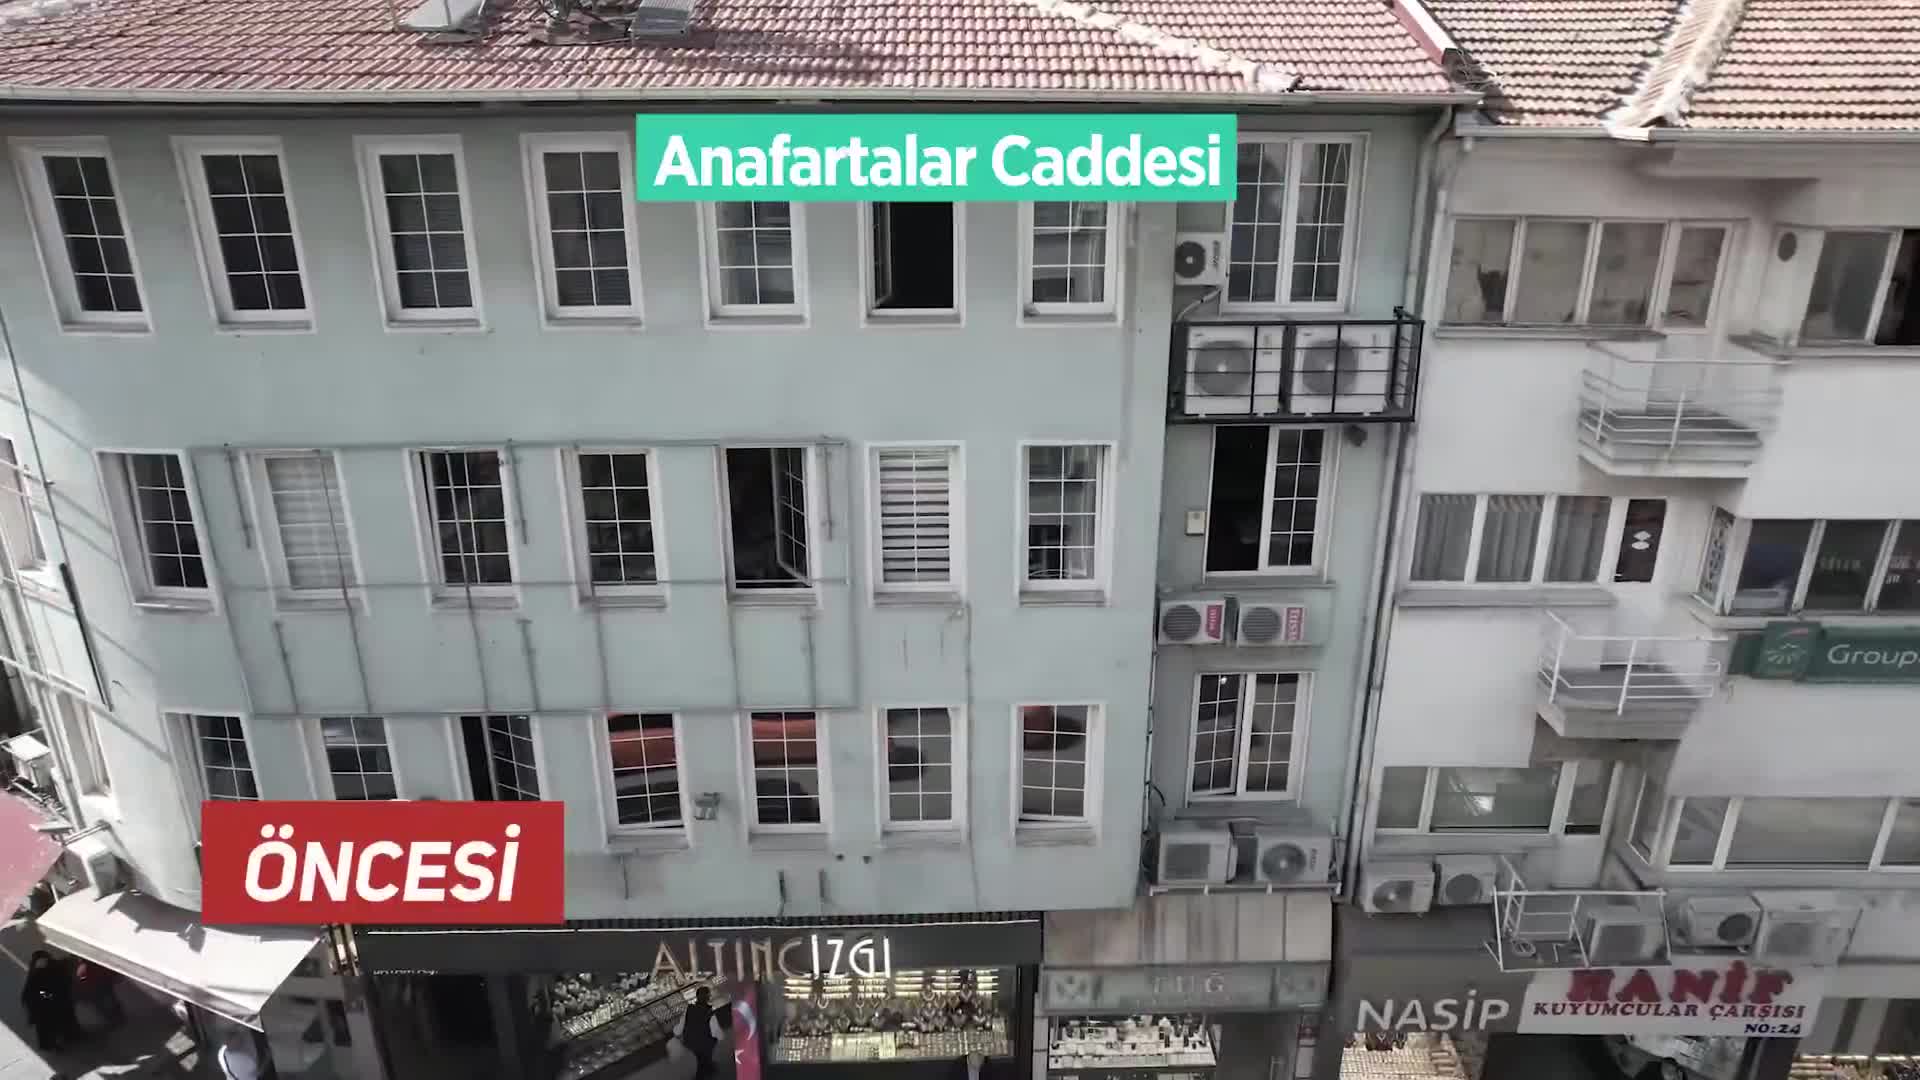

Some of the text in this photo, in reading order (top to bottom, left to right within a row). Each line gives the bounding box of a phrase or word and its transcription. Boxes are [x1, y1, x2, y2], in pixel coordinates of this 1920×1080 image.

[1827, 643, 1920, 668] Group
[1567, 960, 1794, 1004] HANİF
[1356, 989, 1510, 1032] NASİP
[1533, 1002, 1806, 1020] KUYUMCULAR ÇARŞISI
[1744, 1023, 1801, 1034] NO:24
